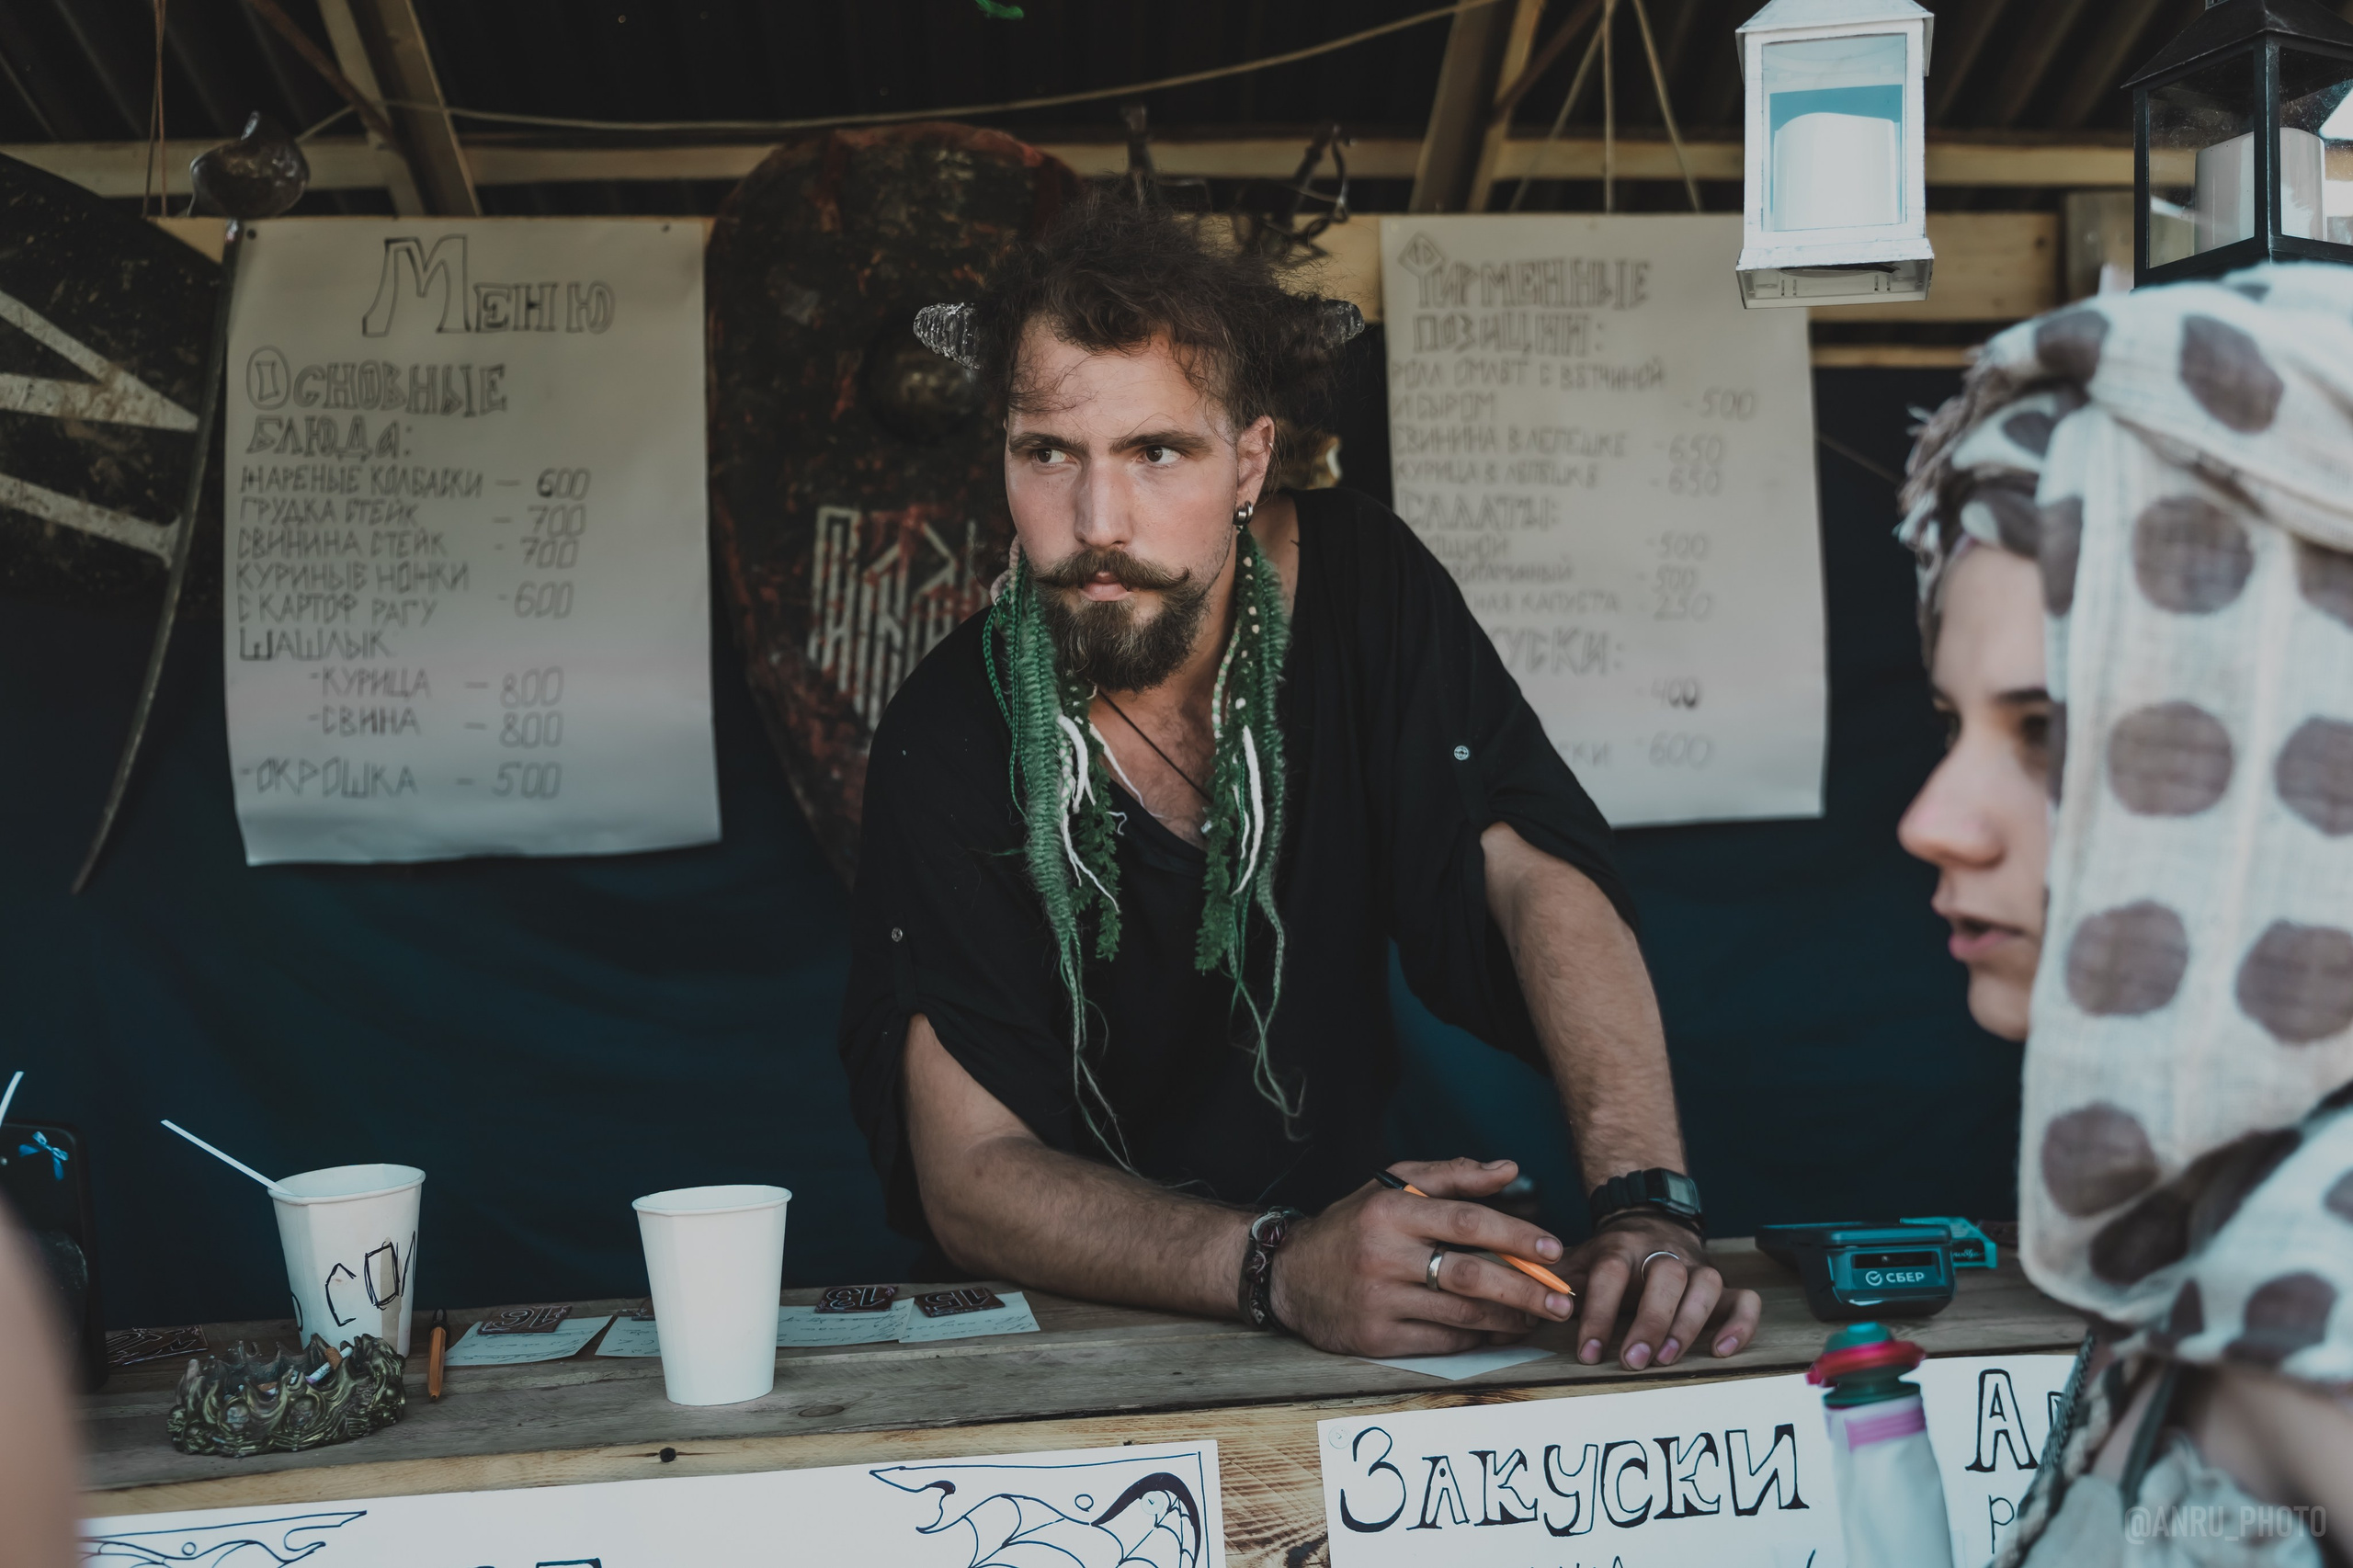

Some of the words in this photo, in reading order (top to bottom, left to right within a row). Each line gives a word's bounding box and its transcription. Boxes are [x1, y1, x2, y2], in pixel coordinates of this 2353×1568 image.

[535, 467, 592, 501] 600
[239, 497, 336, 528] ГРУДКА
[527, 503, 587, 538] 700
[237, 527, 365, 560] СВИНИНА
[369, 526, 449, 559] СТЕЙК
[519, 536, 581, 570] 700
[236, 559, 368, 593] КУРИНЫЕ
[259, 591, 358, 626] КАРТОФ
[370, 597, 438, 629] РАГУ
[238, 627, 398, 663] ШАШЛЫК
[499, 665, 564, 710] 800
[498, 710, 564, 750] 800
[490, 760, 563, 801] 500
[1885, 1271, 1926, 1284] СБЕР
